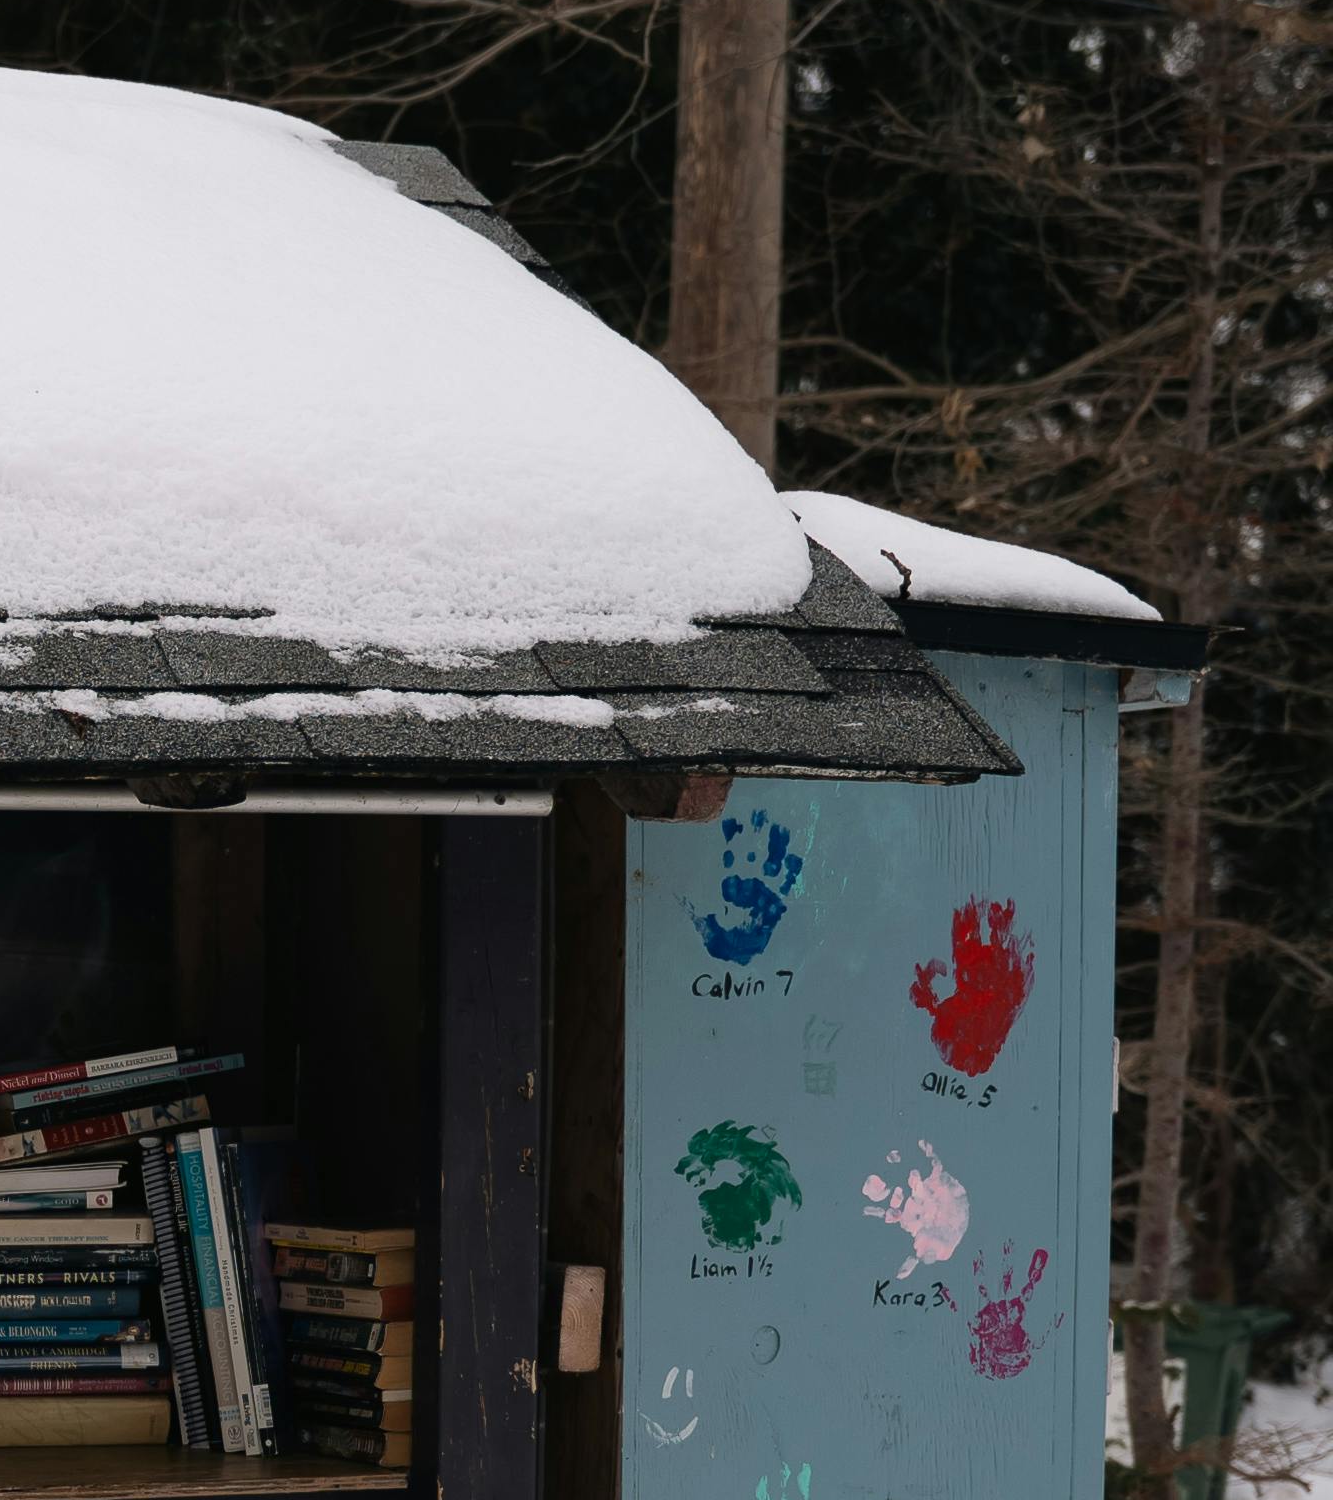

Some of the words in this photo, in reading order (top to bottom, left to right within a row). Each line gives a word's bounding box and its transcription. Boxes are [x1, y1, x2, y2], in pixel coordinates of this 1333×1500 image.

[691, 973, 765, 1000] Calvin
[776, 970, 793, 997] 7
[91, 1062, 124, 1074] BARBARA
[125, 1052, 173, 1068] EHRENREICH
[0, 1075, 29, 1090] Nickel
[31, 1074, 48, 1084] and
[49, 1068, 80, 1082] Dimed
[978, 1085, 997, 1107] 5
[55, 1197, 79, 1205] GOTO
[186, 1153, 210, 1231] HOSPITALITY
[31, 1254, 63, 1264] Windows
[198, 1234, 221, 1305] FINANCIAL
[691, 1254, 737, 1278] Liam
[63, 1271, 116, 1284] RIVALS
[219, 1258, 235, 1301] Handmade
[0, 1326, 6, 1337] &
[8, 1325, 57, 1338] BELONGING
[226, 1303, 241, 1345] Christmas
[30, 1362, 78, 1371] FRIENDS
[209, 1309, 236, 1402] ACCOUNTING
